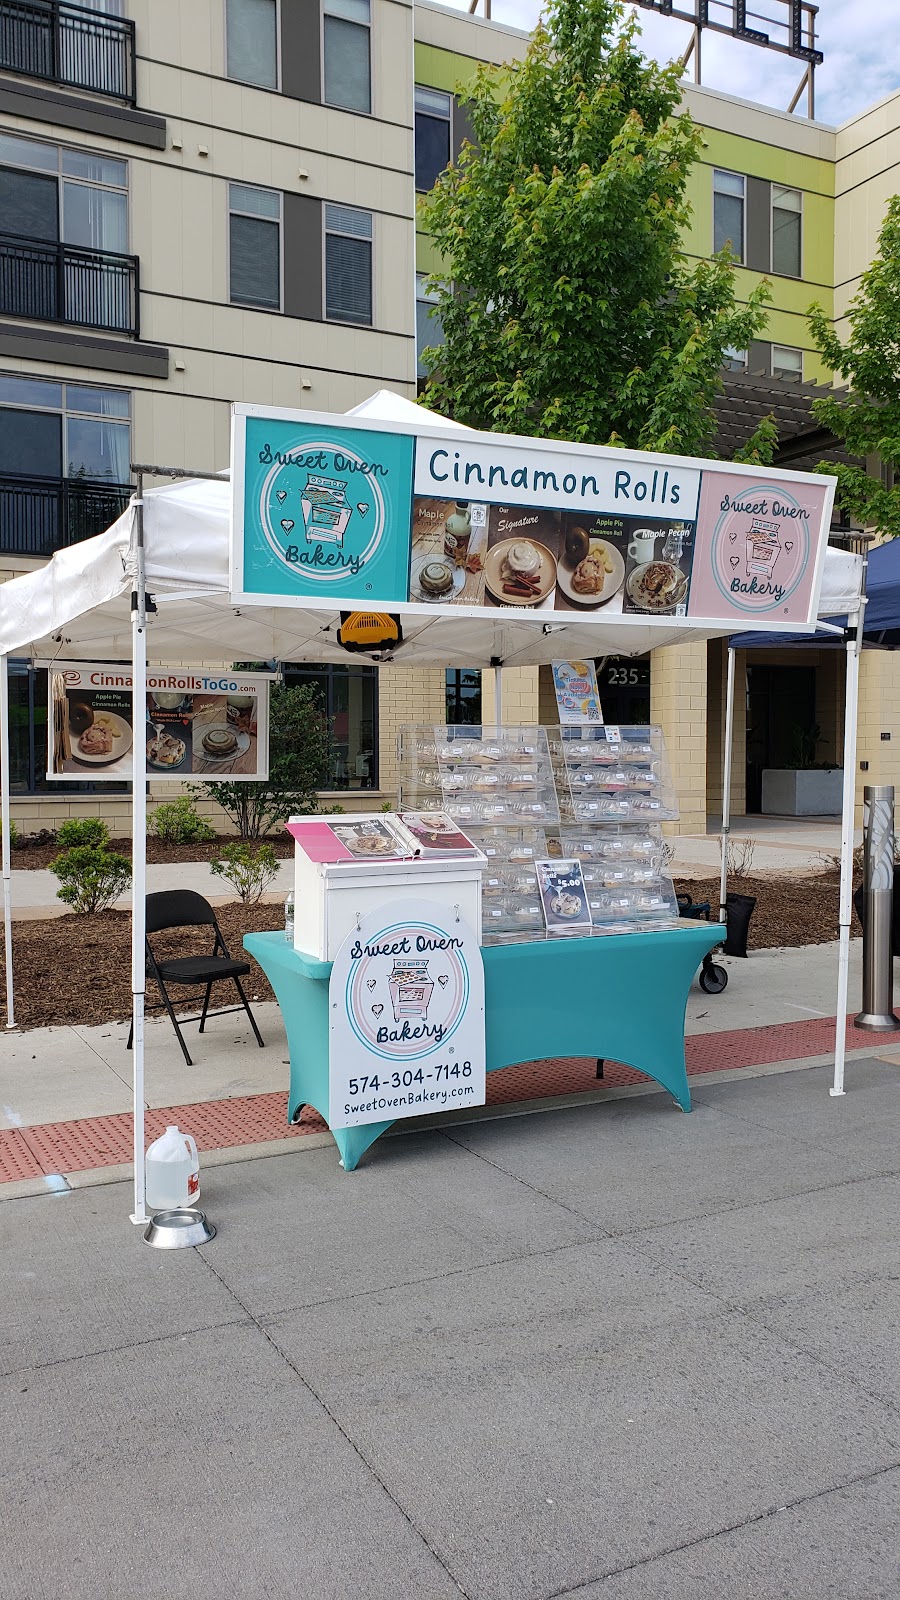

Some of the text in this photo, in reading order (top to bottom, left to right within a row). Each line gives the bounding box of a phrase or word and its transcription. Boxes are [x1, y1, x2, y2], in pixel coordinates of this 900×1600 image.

[258, 443, 389, 477] Sweet Oven
[429, 449, 681, 504] Cinnamon Rolls
[418, 508, 445, 519] Maple
[720, 494, 811, 520] Sweet Oven
[497, 515, 540, 533] Signature
[589, 528, 612, 536] Cinnamon
[596, 518, 623, 527] Apple Pie
[641, 529, 666, 539] Maple
[285, 544, 365, 575] Bakery
[730, 576, 786, 601] Bakery
[90, 672, 256, 693] CinnaonRollsToGo.com
[608, 667, 639, 685] 235
[558, 879, 580, 887] $5.00
[351, 935, 464, 959] Sweet Oven
[376, 1020, 448, 1043] Bakery
[349, 1061, 473, 1095] 574-304-7148
[344, 1086, 474, 1115] SweetOvenBakery.com
